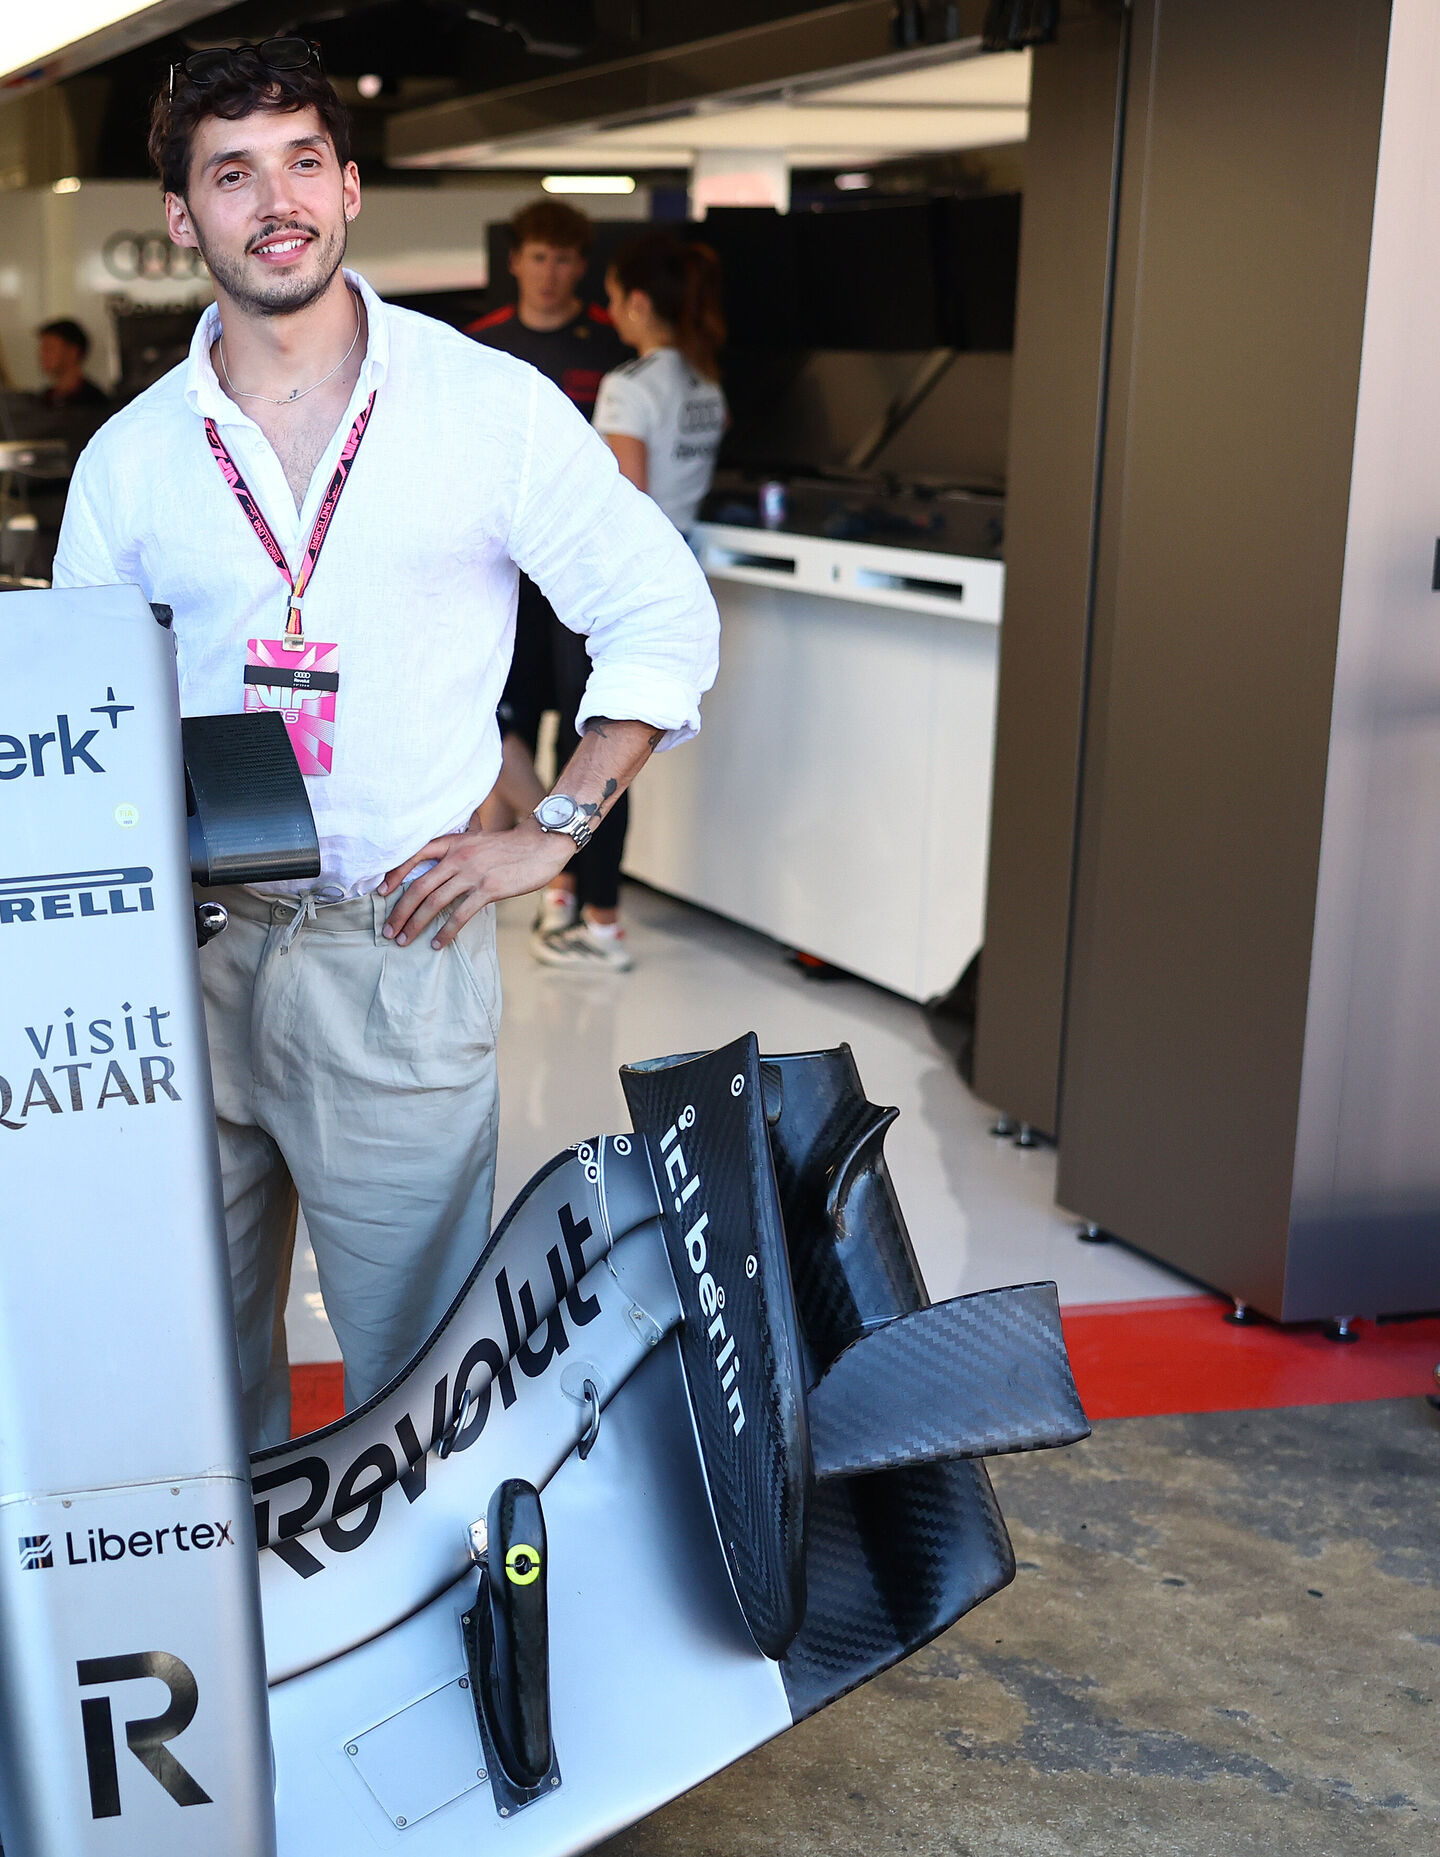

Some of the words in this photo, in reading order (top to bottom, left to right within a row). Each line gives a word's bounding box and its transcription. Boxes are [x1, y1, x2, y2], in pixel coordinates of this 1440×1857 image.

[252, 517, 282, 564] BARCELONA
[310, 502, 333, 551] BARCELONA
[255, 684, 322, 709] VIP
[24, 1001, 172, 1060] visit
[684, 1211, 746, 1437] berlin
[253, 1202, 602, 1579] Revolut
[66, 1520, 235, 1565] Libertex
[76, 1651, 214, 1819] R
